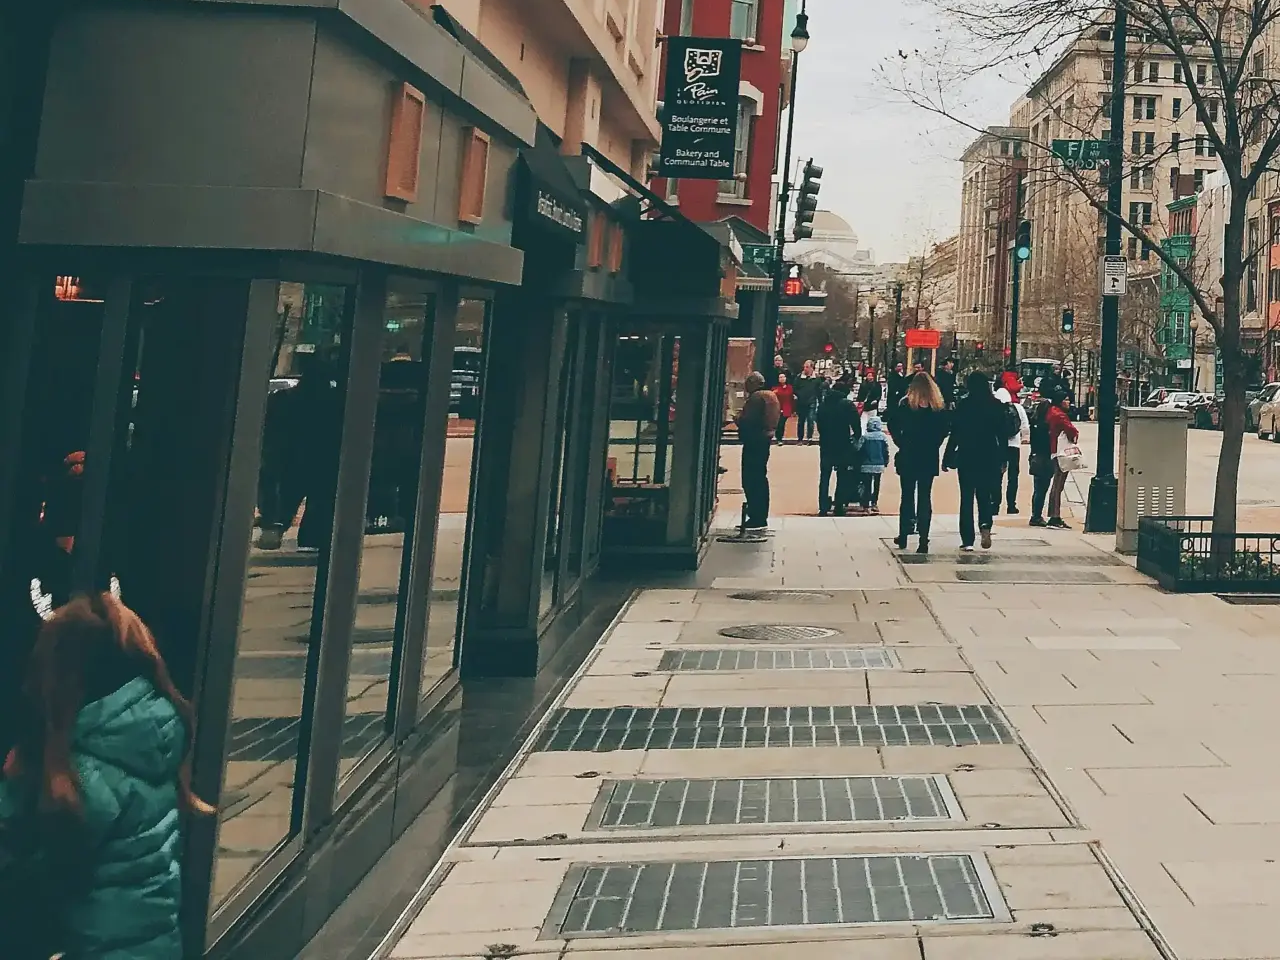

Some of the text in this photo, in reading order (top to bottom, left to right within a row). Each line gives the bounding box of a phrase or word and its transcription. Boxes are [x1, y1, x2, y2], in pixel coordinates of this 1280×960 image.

[671, 115, 729, 125] Boulangerie et
[667, 124, 731, 134] Table Commune
[1068, 141, 1079, 156] F
[676, 149, 720, 159] Bakery and
[664, 157, 730, 168] Communal Table
[753, 248, 760, 256] F
